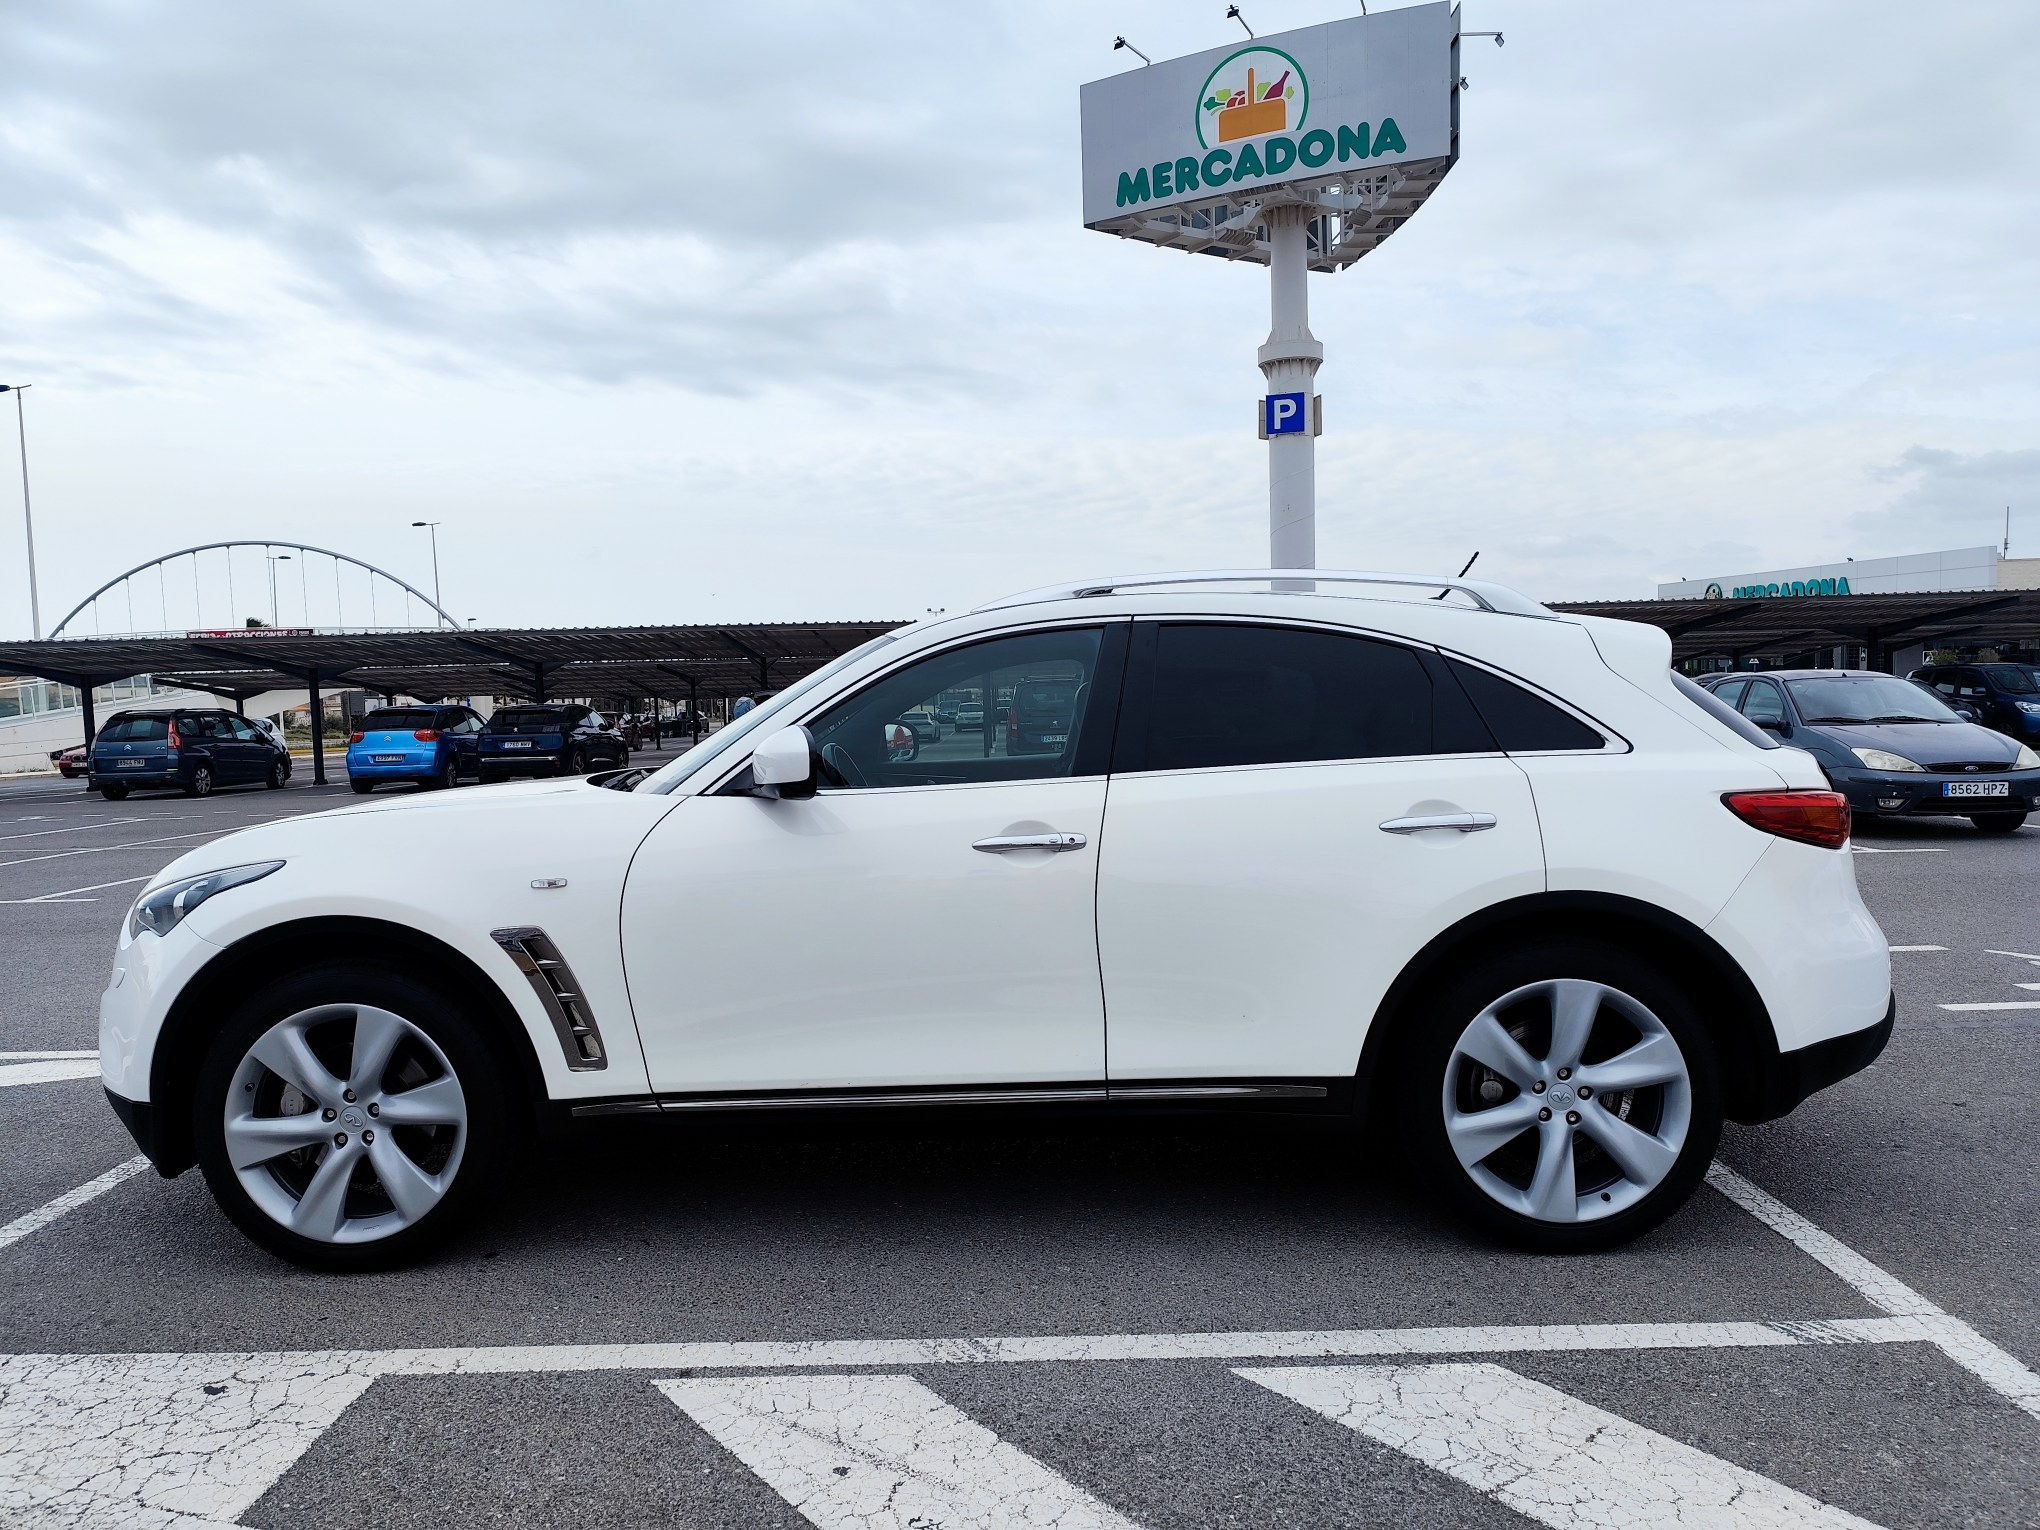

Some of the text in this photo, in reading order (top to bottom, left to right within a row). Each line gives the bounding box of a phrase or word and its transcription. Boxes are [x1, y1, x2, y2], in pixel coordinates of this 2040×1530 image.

[1116, 117, 1407, 208] MERCADONA
[1274, 399, 1297, 430] P
[1951, 784, 2006, 795] 8562 HPZ
